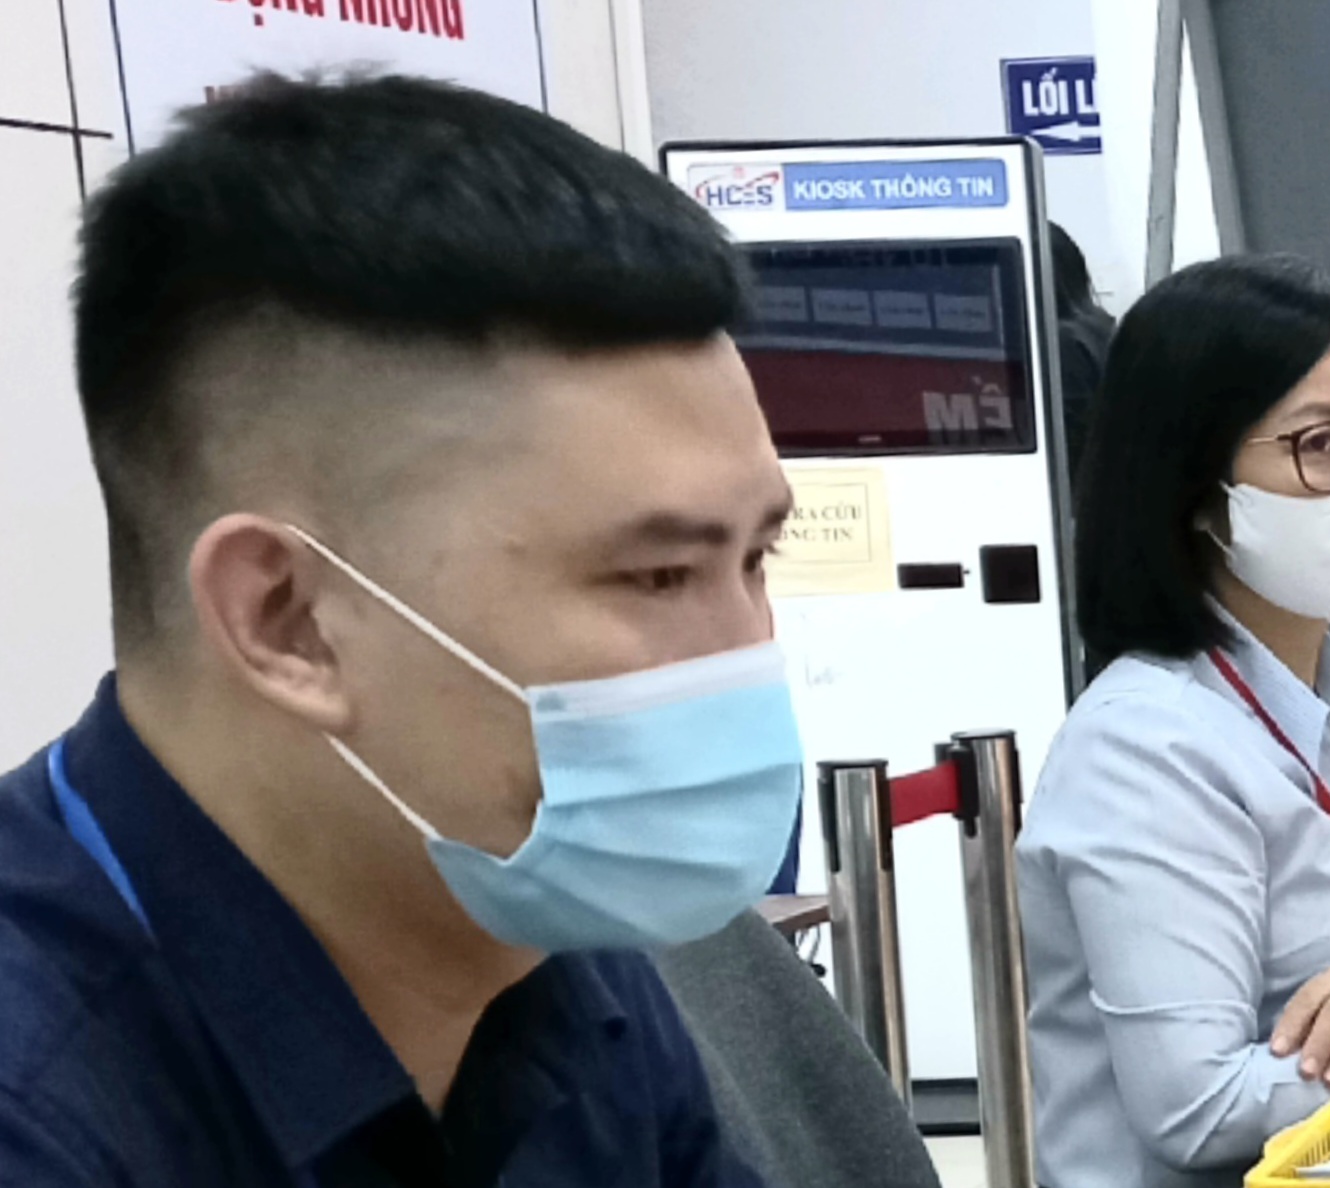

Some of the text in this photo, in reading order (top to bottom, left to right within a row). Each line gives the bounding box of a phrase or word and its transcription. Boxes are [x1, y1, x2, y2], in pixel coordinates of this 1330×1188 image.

[1022, 67, 1069, 116] LỐI
[793, 172, 993, 201] KIOSK THÔNG TIN
[793, 505, 818, 520] RA
